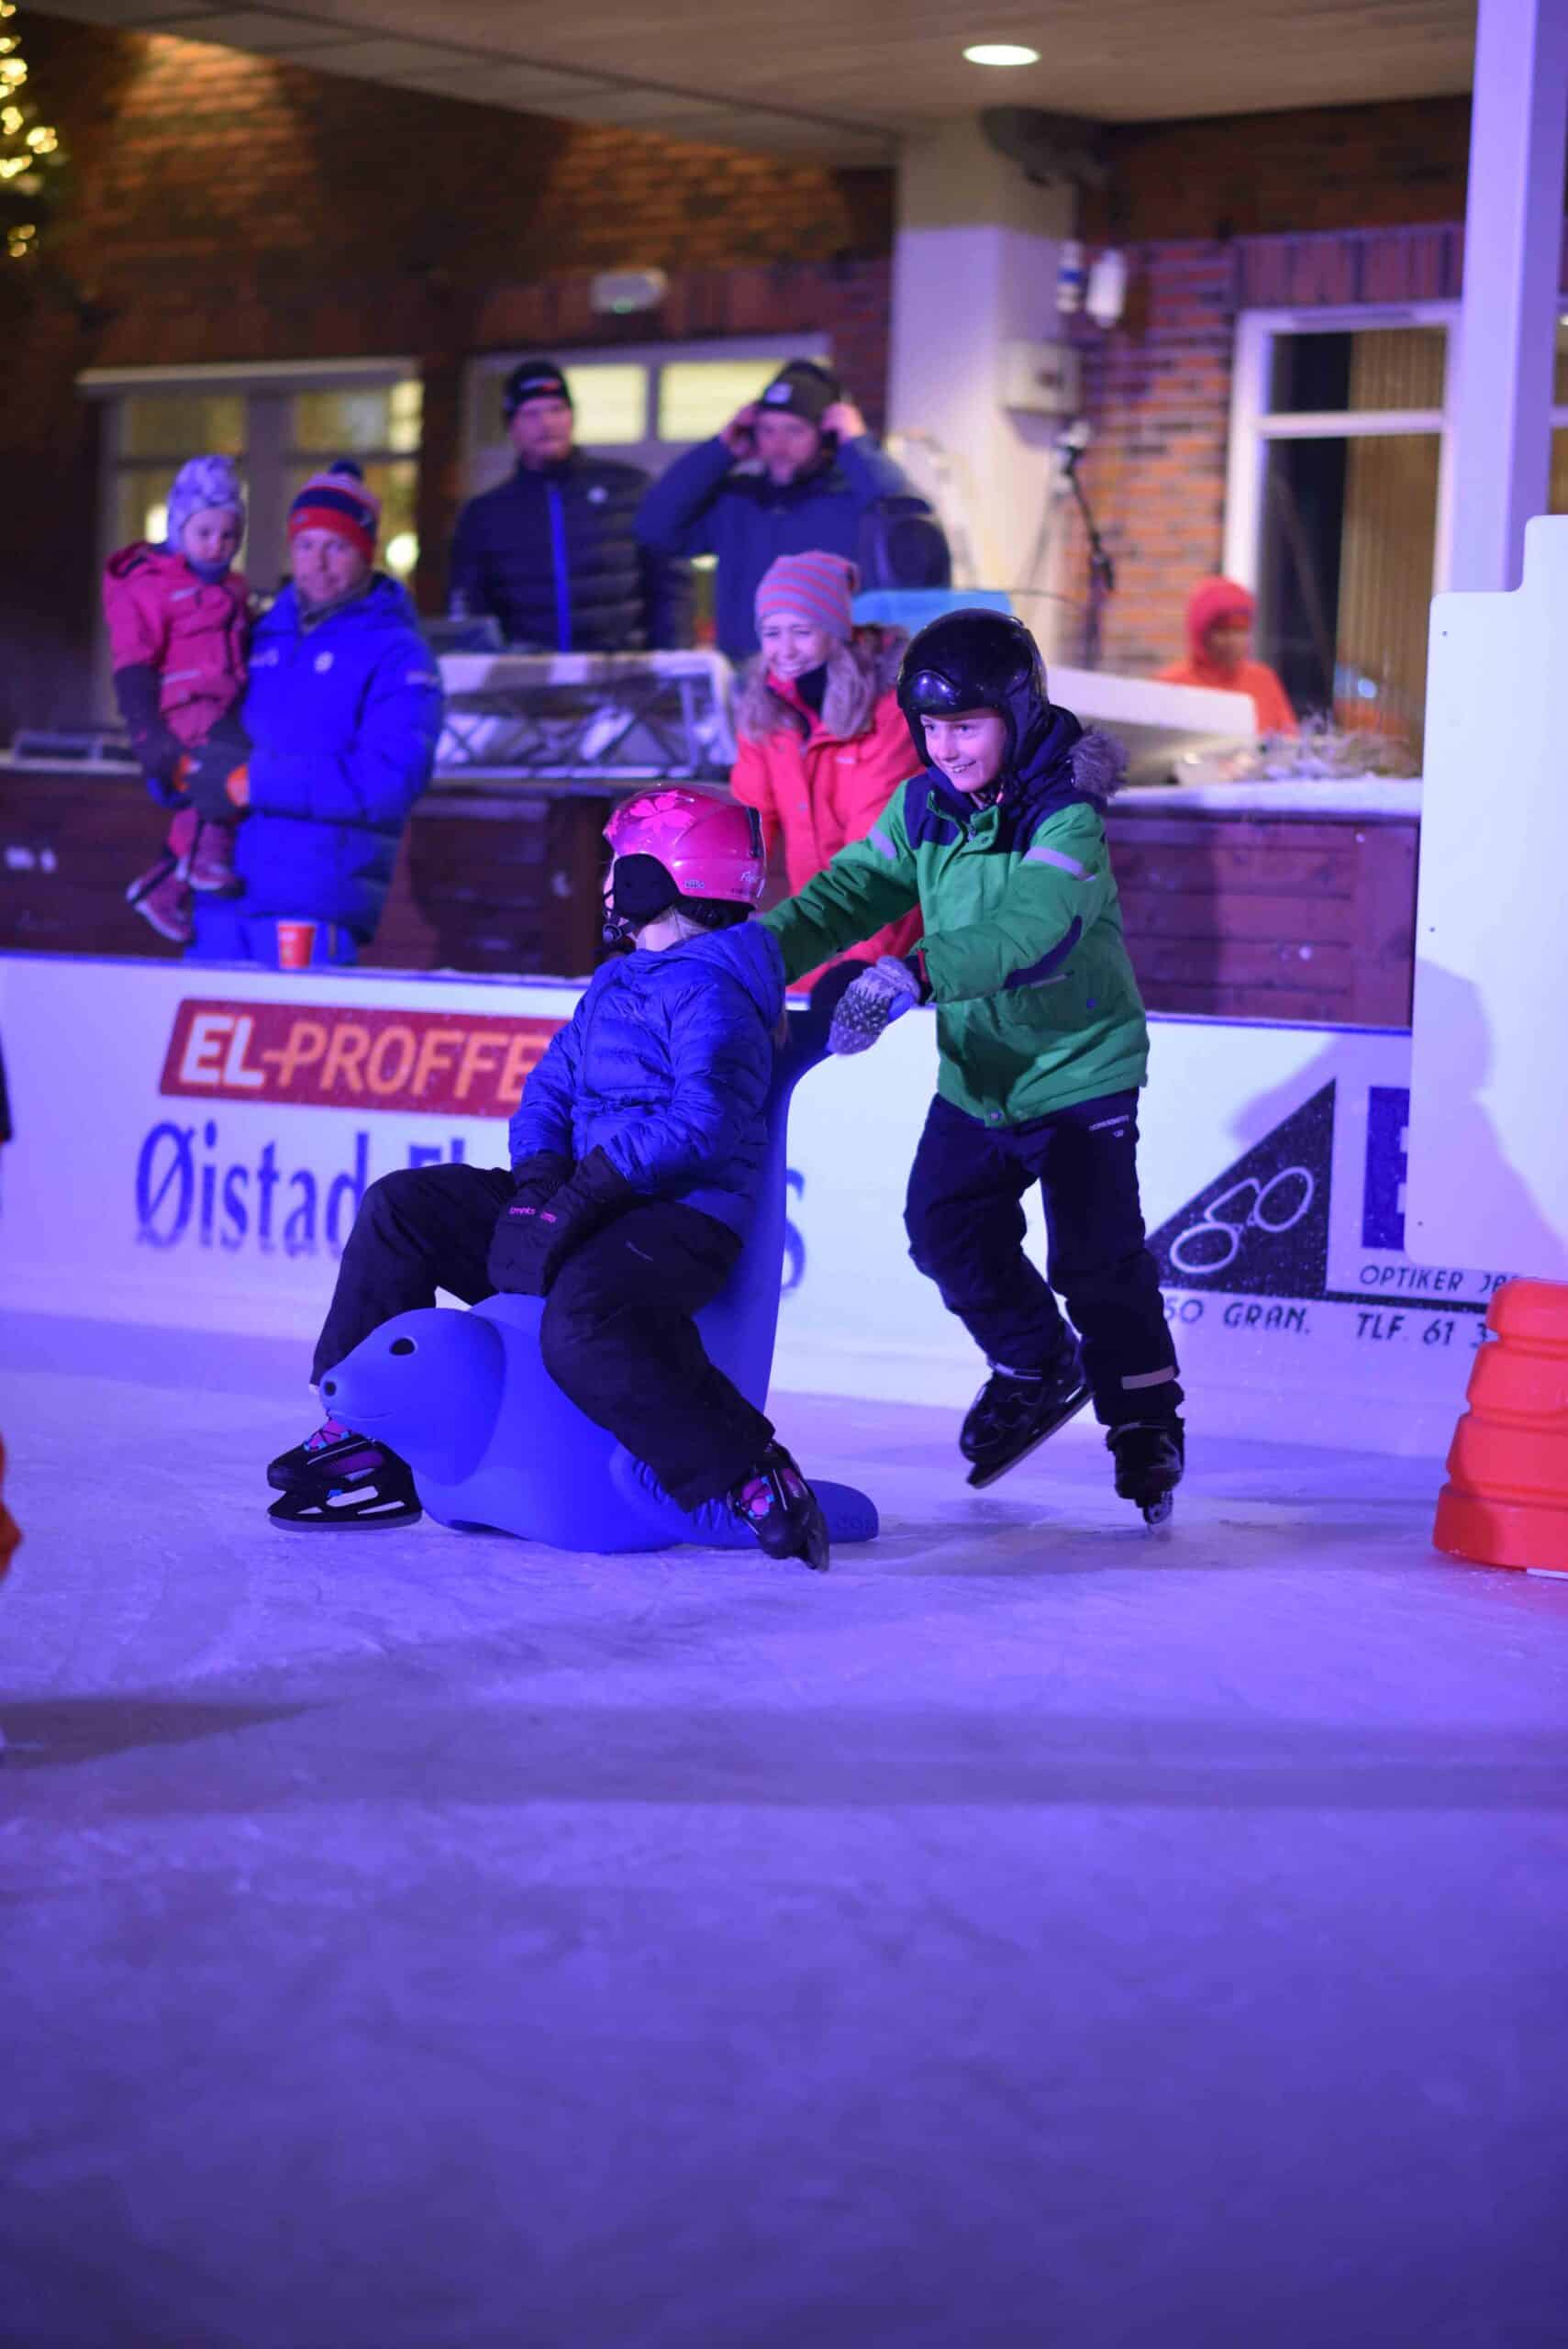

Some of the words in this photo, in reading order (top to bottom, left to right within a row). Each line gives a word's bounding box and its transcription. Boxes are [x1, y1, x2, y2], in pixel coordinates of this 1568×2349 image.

[136, 1119, 369, 1259] Øistad
[1360, 1264, 1463, 1293] OPTIKER
[1423, 1318, 1455, 1346] 61
